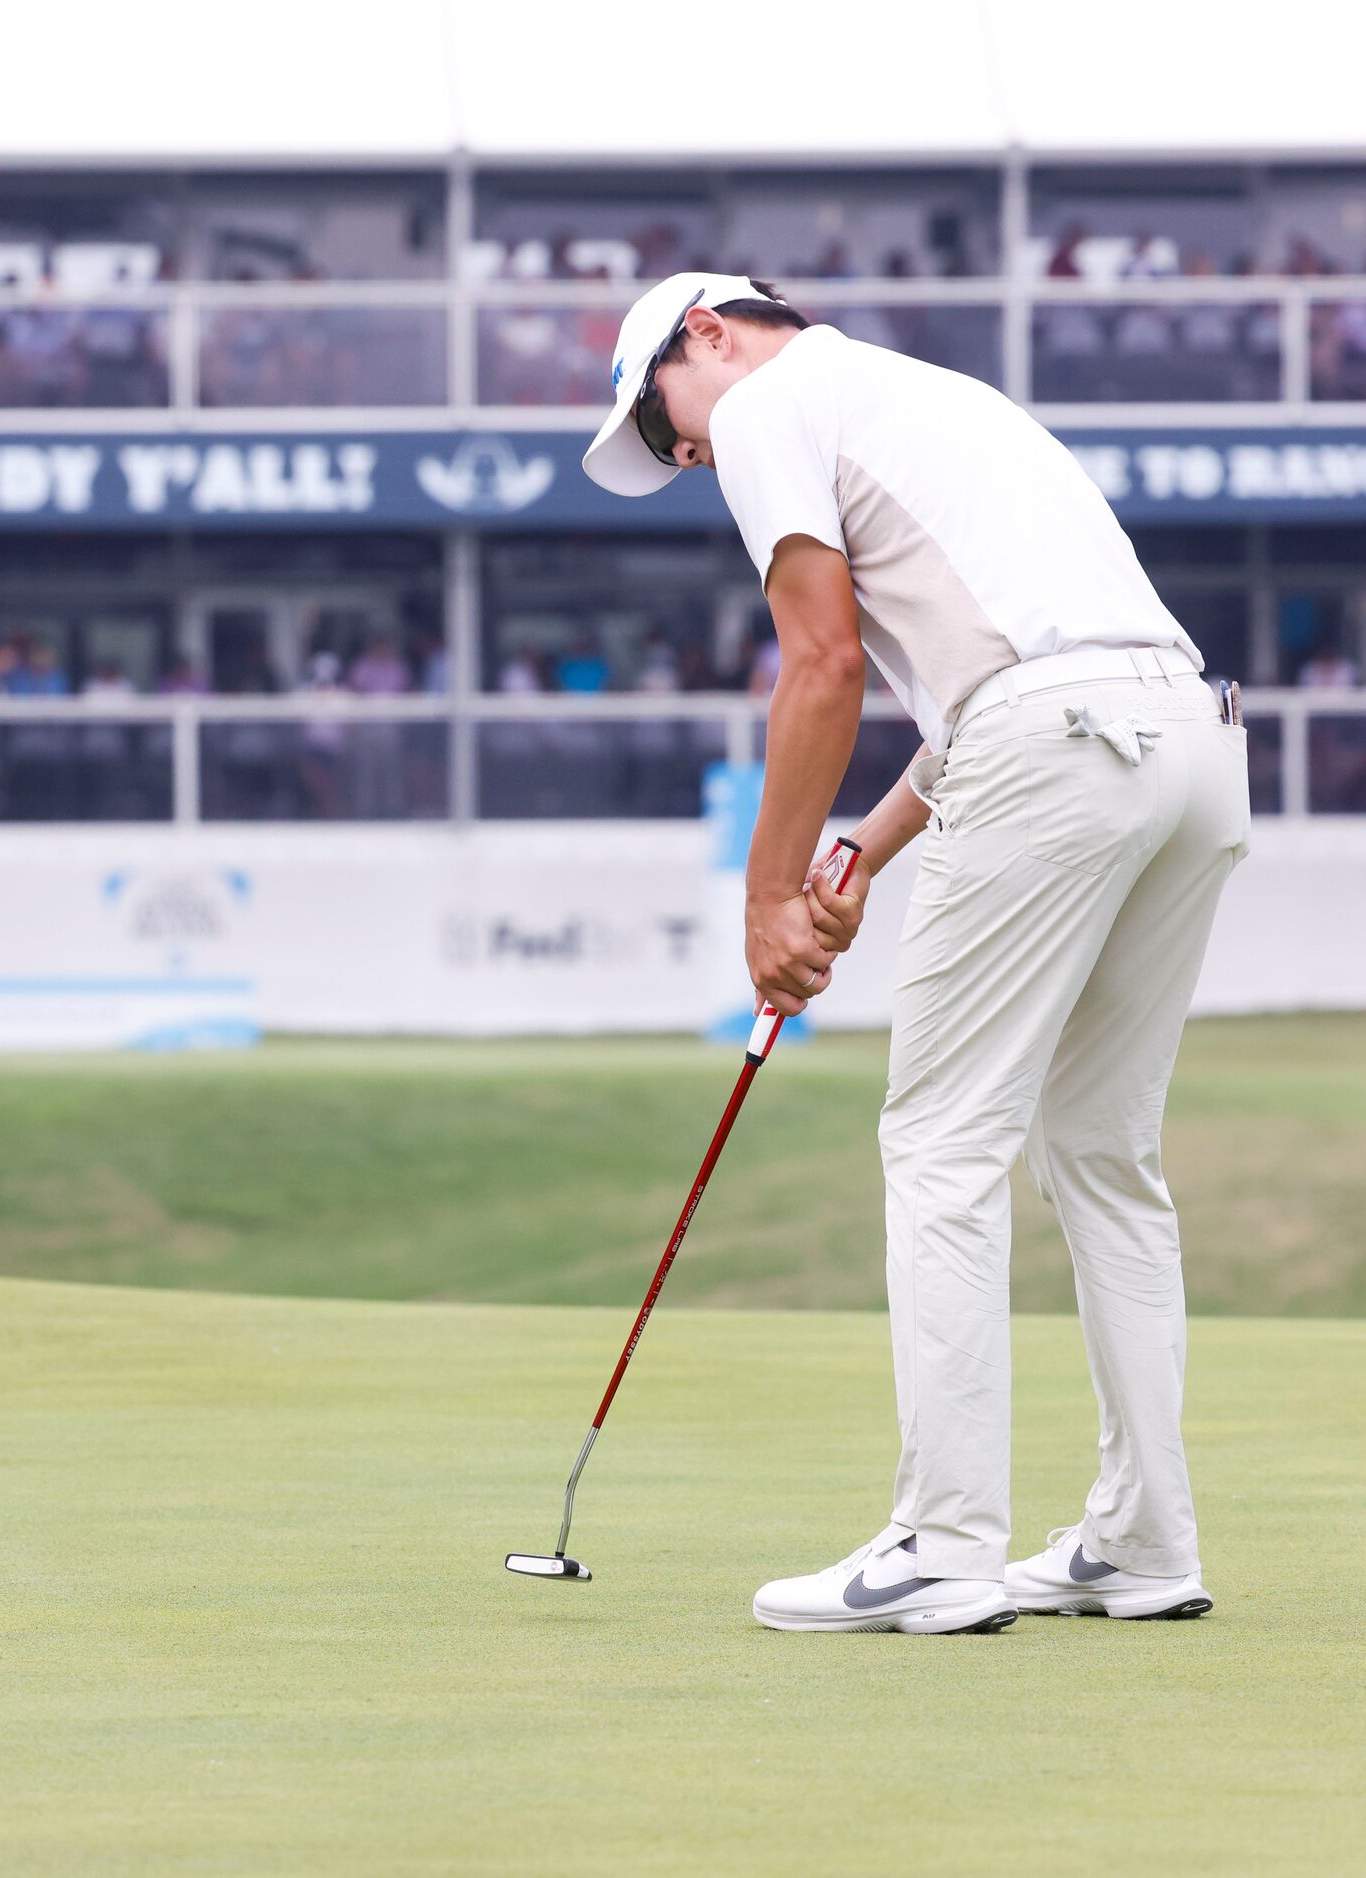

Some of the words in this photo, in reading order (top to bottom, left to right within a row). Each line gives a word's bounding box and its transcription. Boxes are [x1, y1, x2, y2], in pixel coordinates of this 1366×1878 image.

[120, 445, 375, 513] Y'ALL!
[1137, 444, 1225, 499] TO
[682, 1185, 703, 1228] STROKE
[671, 1230, 685, 1253] LAB
[625, 1316, 648, 1361] ODYSSEY
